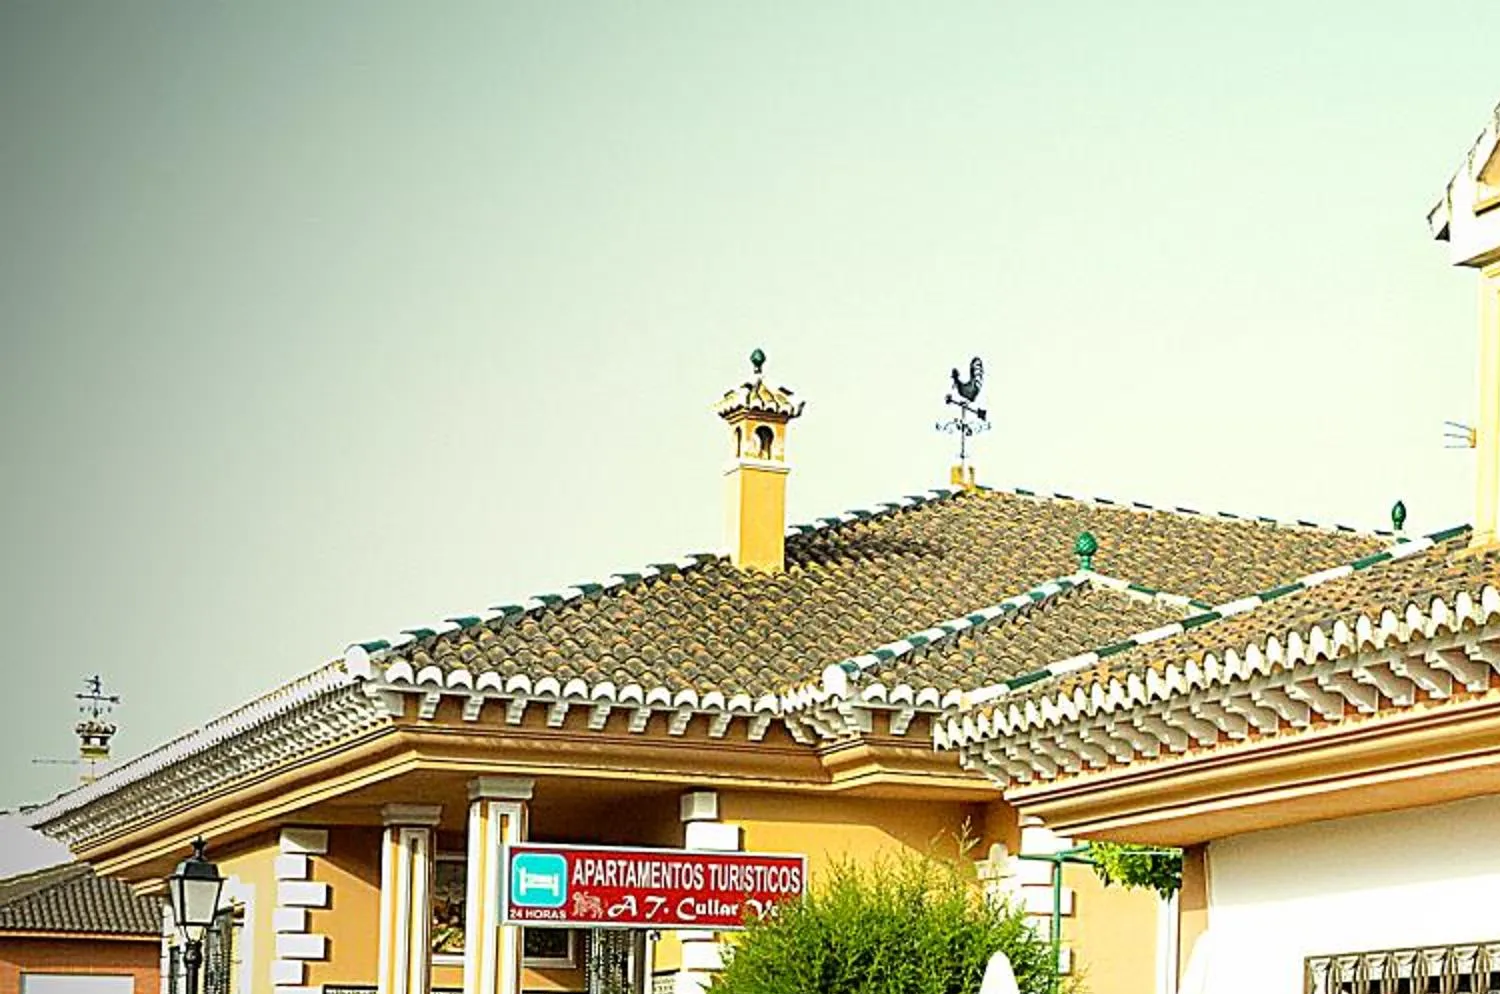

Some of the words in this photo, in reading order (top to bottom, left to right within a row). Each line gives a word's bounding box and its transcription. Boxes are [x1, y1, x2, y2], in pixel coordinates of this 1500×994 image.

[572, 859, 704, 891] APARTAMENTOS
[708, 863, 801, 894] TURISTICOS
[509, 909, 523, 919] 24
[525, 909, 567, 920] HORAS
